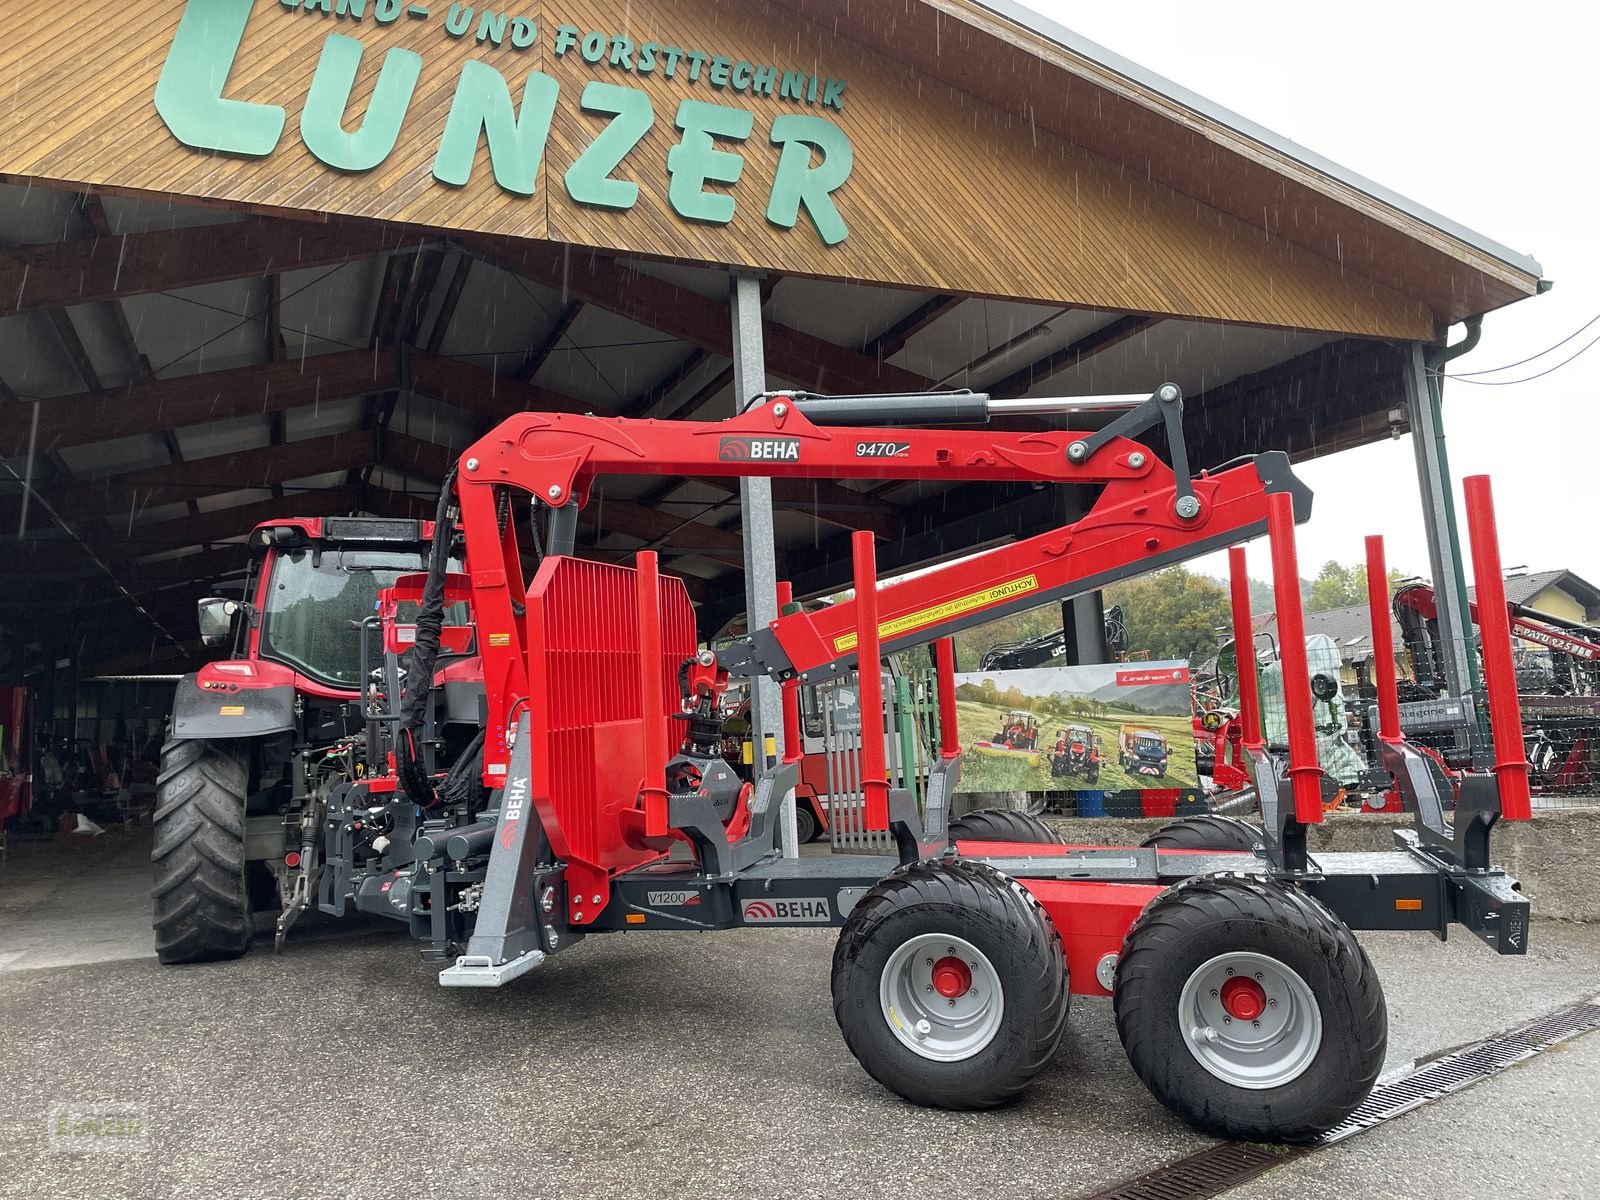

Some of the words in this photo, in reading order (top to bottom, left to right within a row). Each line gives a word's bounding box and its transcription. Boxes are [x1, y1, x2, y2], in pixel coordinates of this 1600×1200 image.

[445, 3, 537, 49] UND
[555, 24, 846, 111] FORSTTECHNIK
[154, 0, 853, 246] LUNZER
[751, 441, 799, 459] BEHA
[856, 443, 896, 457] 9470
[990, 578, 1033, 599] ACHTUNG!
[954, 593, 987, 610] Aufenthalt
[892, 608, 944, 630] Gefahrenbereich
[1050, 645, 1067, 657] JC
[505, 776, 528, 820] BEHA
[649, 893, 686, 904] V1200
[776, 902, 828, 918] BEHA
